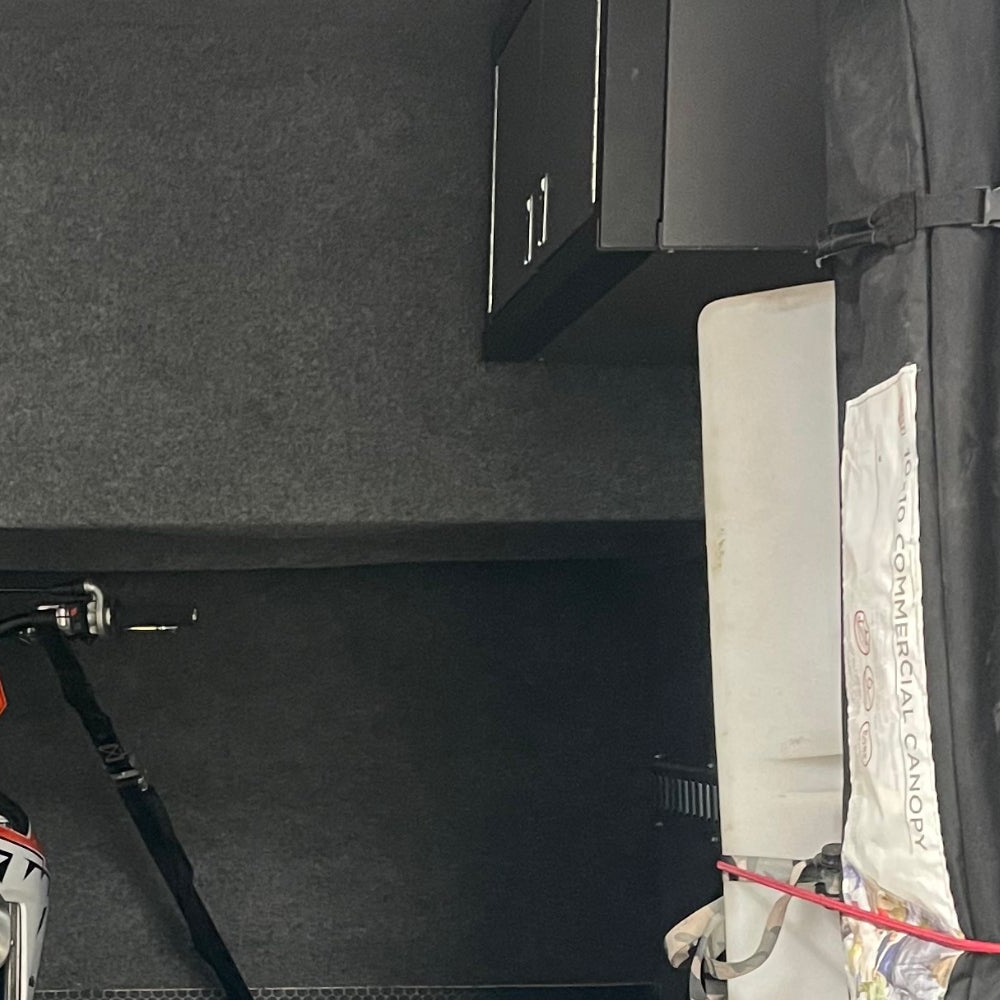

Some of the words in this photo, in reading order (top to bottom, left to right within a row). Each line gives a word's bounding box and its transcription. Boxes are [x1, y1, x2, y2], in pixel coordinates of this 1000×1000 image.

[903, 448, 912, 477] 10
[896, 495, 907, 523] 10
[893, 534, 914, 724] COMMERCIAL
[903, 733, 928, 852] CANOPY
